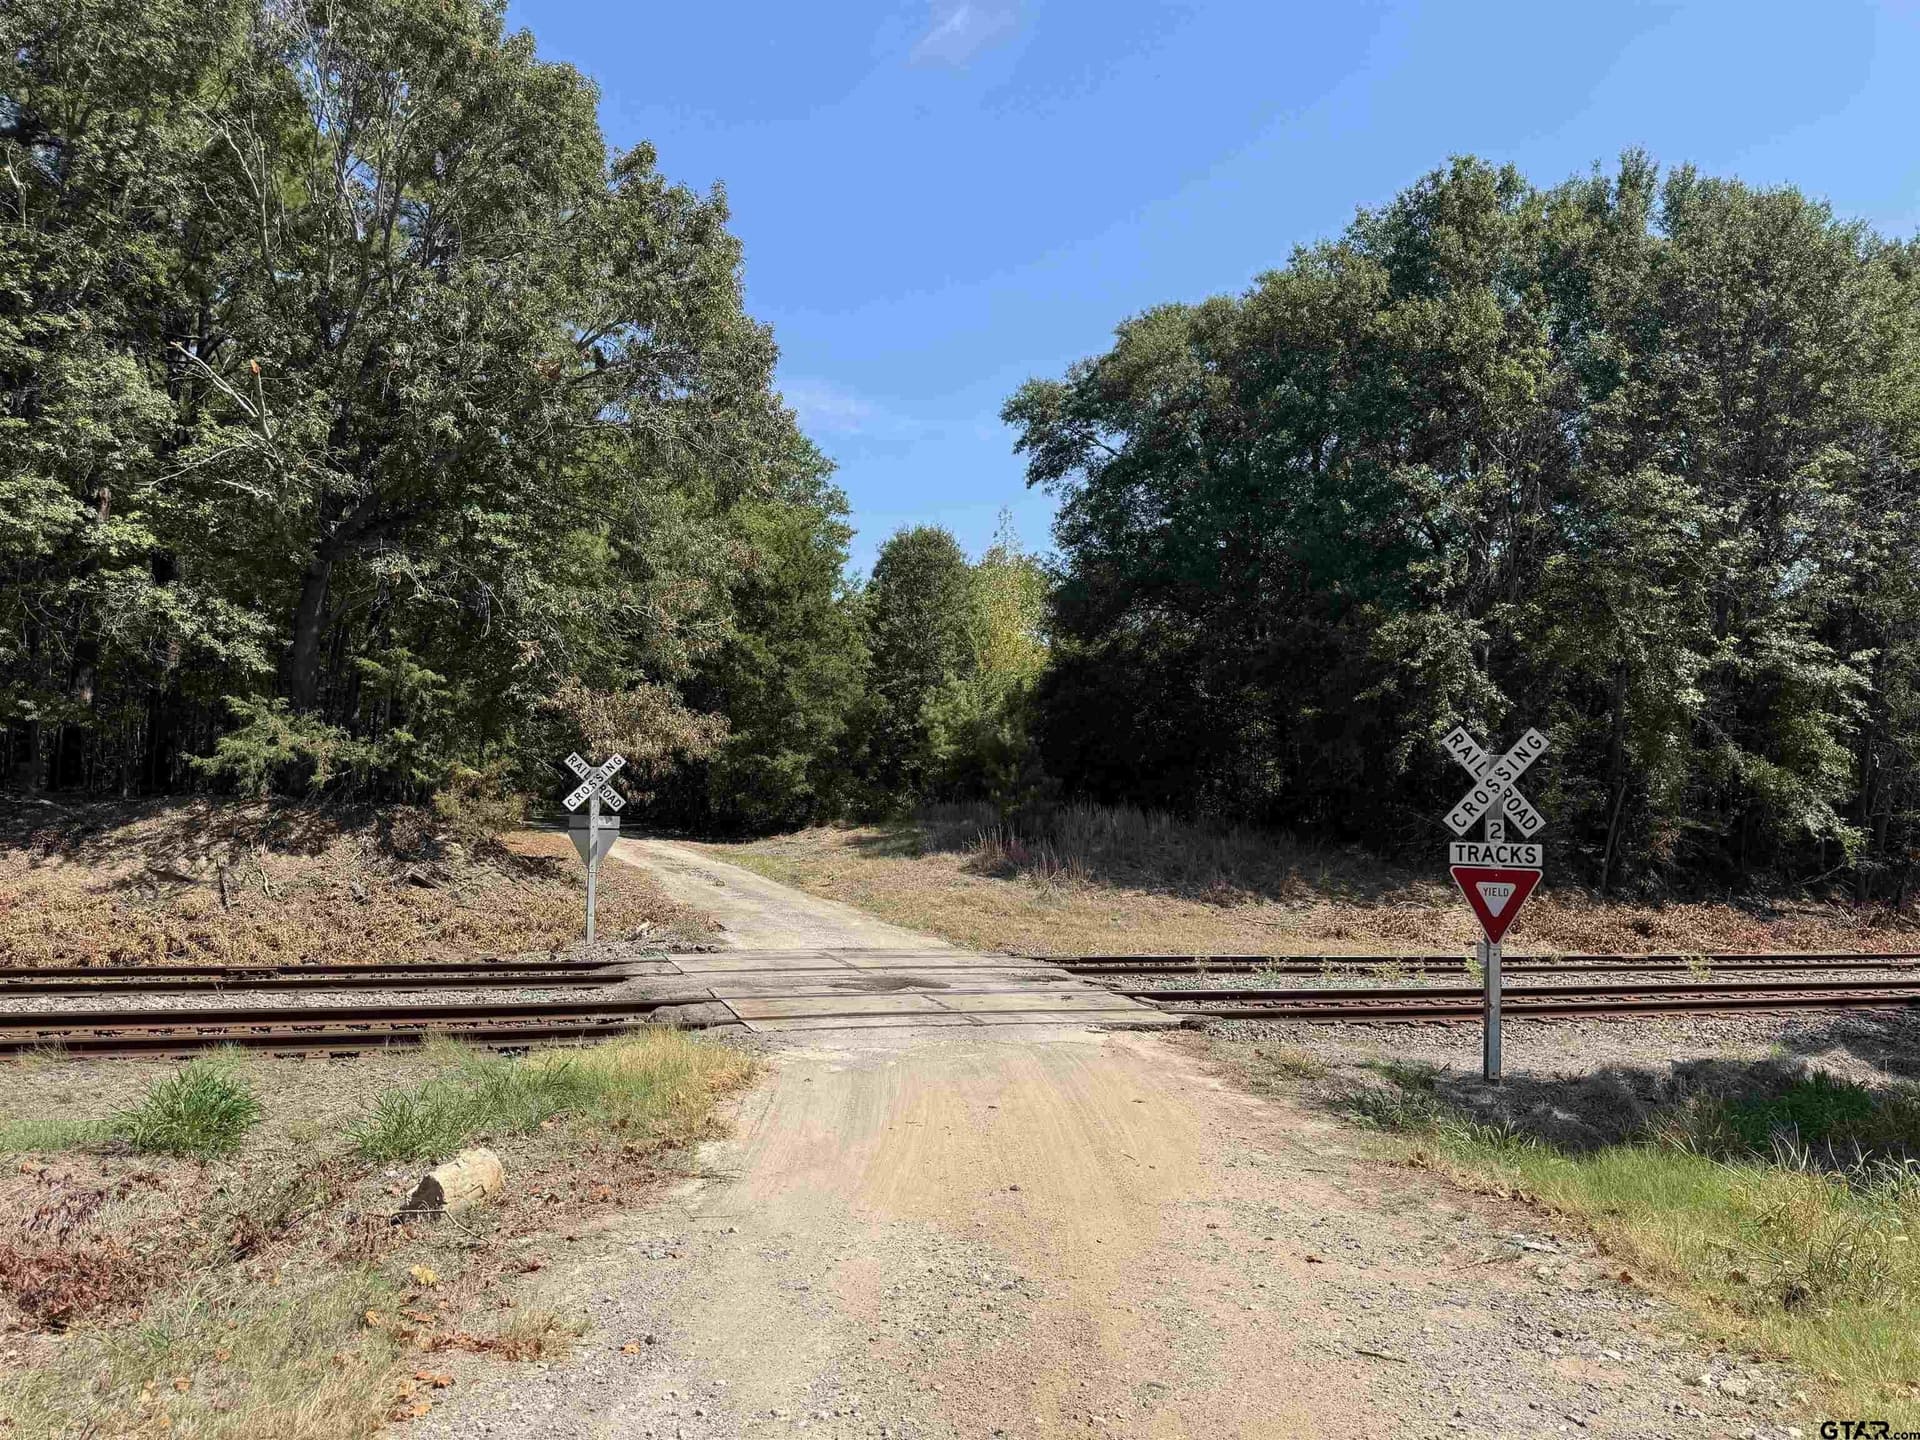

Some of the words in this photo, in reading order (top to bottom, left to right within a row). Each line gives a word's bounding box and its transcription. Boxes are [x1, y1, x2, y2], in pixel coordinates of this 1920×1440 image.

[568, 756, 591, 780] RAIL
[567, 756, 622, 807] CROSSING
[1448, 733, 1487, 777] RAIL
[1503, 787, 1538, 830] ROAD
[1452, 735, 1542, 828] CROSSING
[1490, 822, 1502, 840] 2
[1455, 844, 1537, 864] TRACKS
[1482, 887, 1509, 897] YIELD
